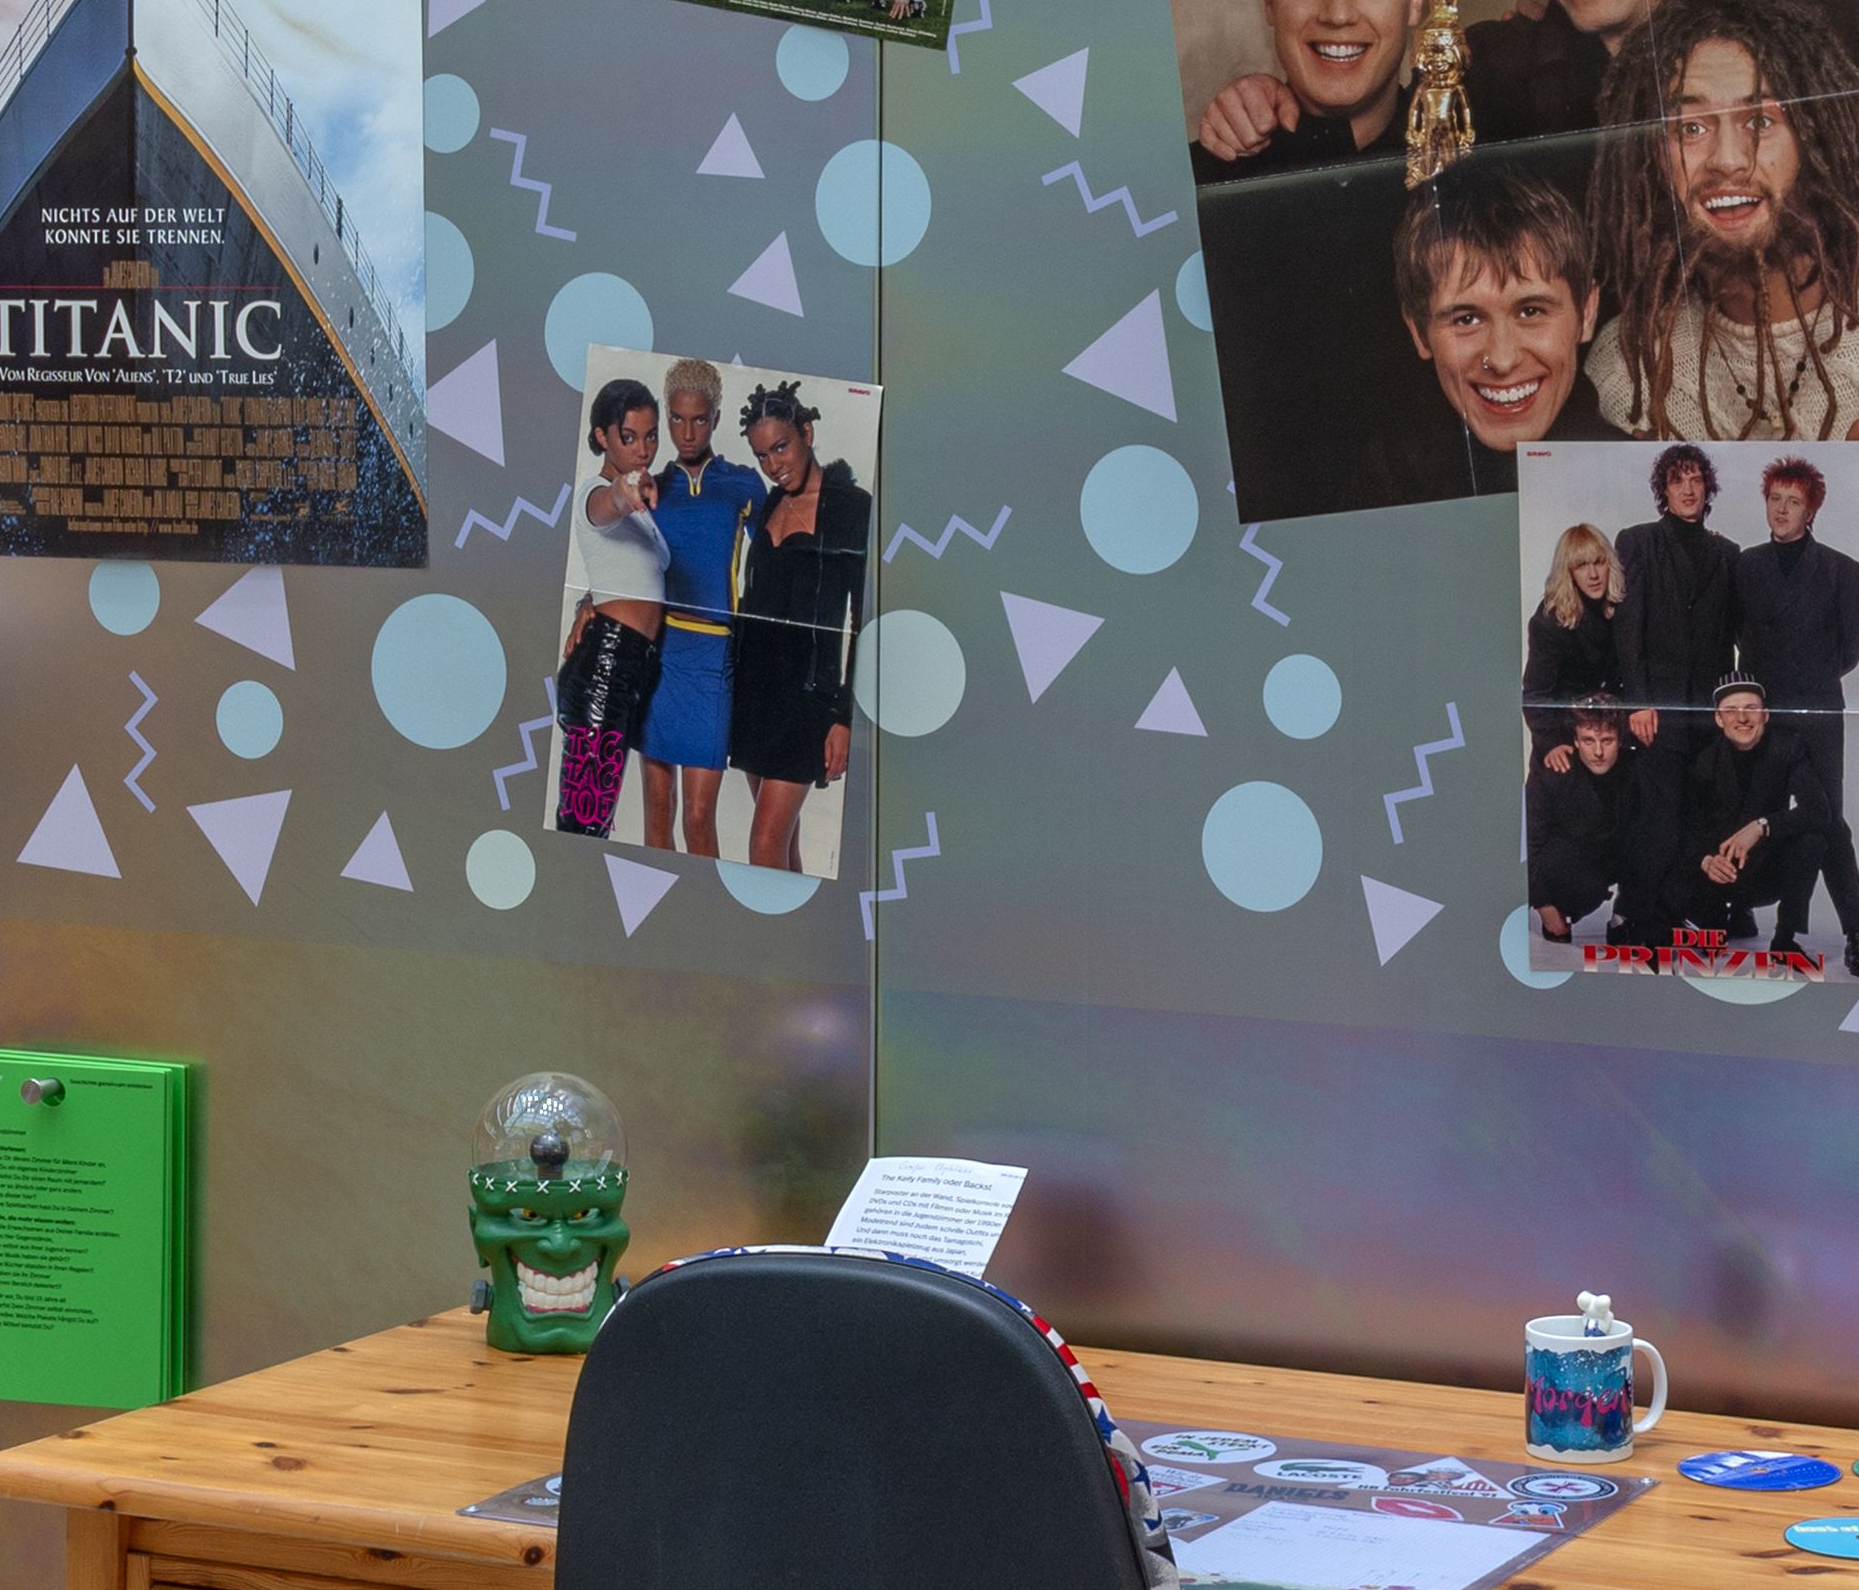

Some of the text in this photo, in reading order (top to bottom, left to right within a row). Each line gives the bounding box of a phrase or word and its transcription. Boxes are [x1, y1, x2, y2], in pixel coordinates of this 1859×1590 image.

[41, 208, 225, 225] NICHTS AUF DER WELT
[44, 227, 226, 245] KONNTE SIE TRENNEN.
[27, 368, 83, 382] REGISSEUR
[564, 726, 624, 765] TIC
[561, 756, 622, 792] TAC
[559, 786, 622, 831] TOE
[1672, 928, 1729, 949] DIE
[1583, 944, 1825, 983] PRINZEN
[882, 1174, 896, 1182] The
[897, 1175, 915, 1184] Kelly
[917, 1176, 941, 1185] Family
[943, 1179, 962, 1187] oder
[1277, 1471, 1364, 1480] LACOSTE
